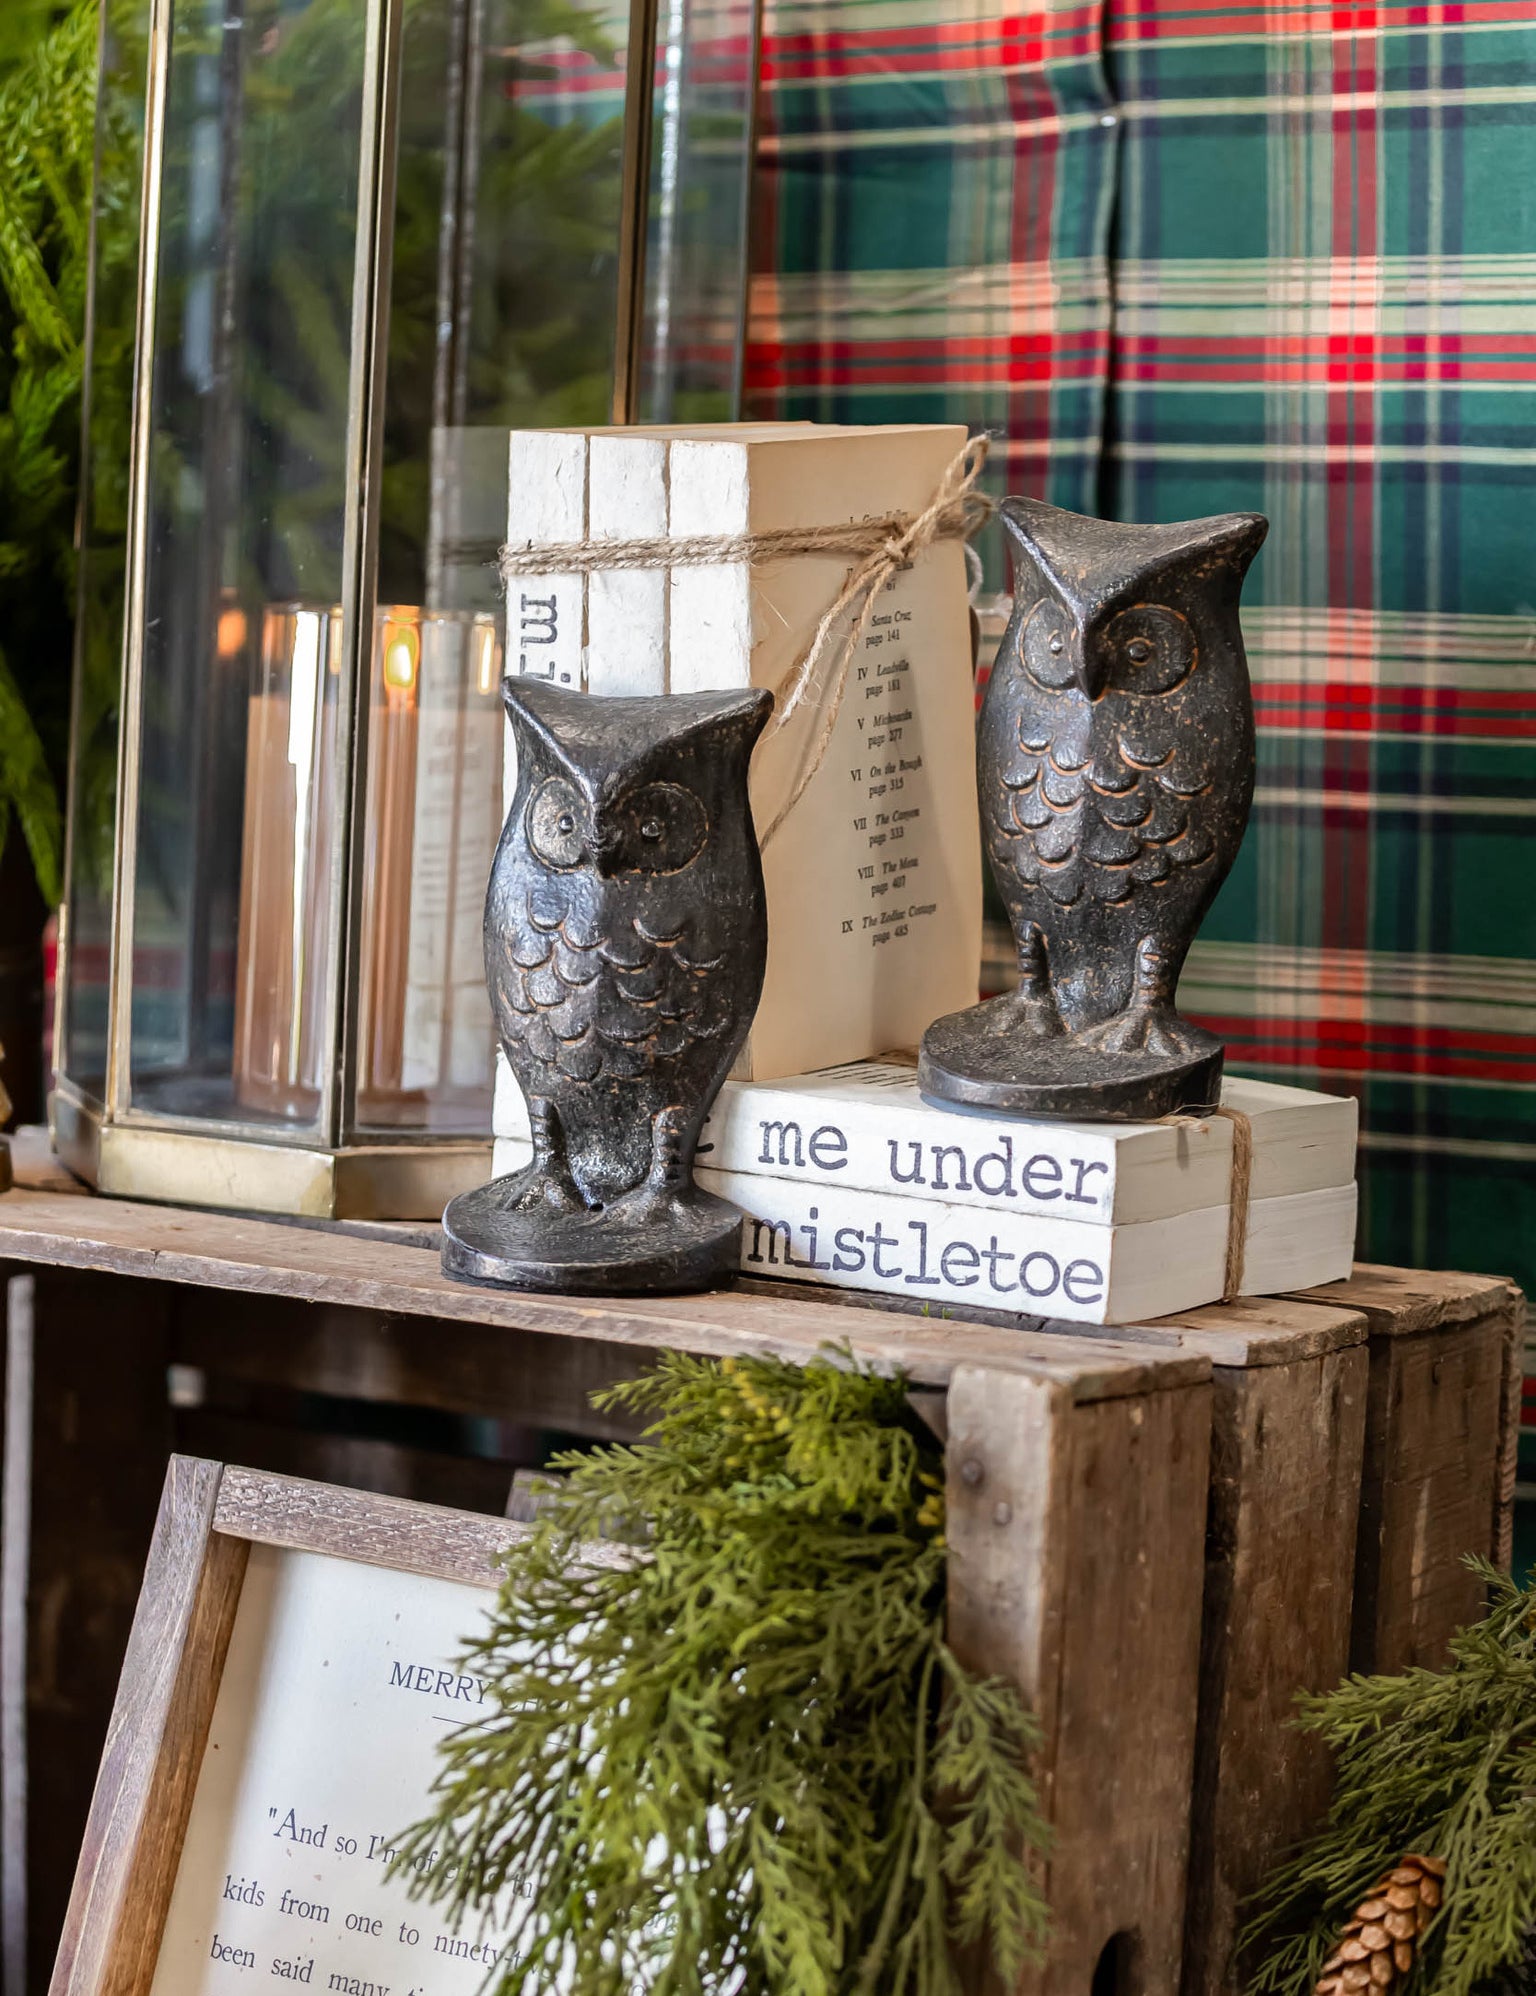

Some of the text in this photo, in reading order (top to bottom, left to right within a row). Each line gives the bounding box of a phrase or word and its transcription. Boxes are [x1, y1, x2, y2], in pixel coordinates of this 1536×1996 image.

[894, 610, 912, 623] Cruz
[865, 629, 900, 648] page 141
[857, 667, 868, 680] IV
[865, 686, 883, 699] page
[857, 718, 864, 730] V
[868, 732, 885, 749] page
[850, 769, 861, 781] VI
[870, 765, 882, 778] On
[884, 762, 896, 774] the
[869, 783, 886, 799] page
[853, 817, 867, 831] VII
[875, 813, 891, 828] The
[869, 832, 886, 848] page
[857, 865, 874, 880] VIII
[882, 861, 898, 875] The
[871, 882, 888, 898] page
[842, 920, 853, 934] IX
[862, 915, 878, 929] The
[872, 931, 890, 947] page
[758, 1120, 848, 1171] me
[887, 1134, 1109, 1205] under
[747, 1206, 1104, 1305] mistletoe
[388, 1660, 495, 1705] MERRY
[334, 1834, 358, 1857] so
[222, 1873, 266, 1907] kids
[279, 1889, 331, 1924] from
[344, 1912, 383, 1937] one
[398, 1921, 420, 1946] to
[209, 1934, 256, 1969] been
[270, 1956, 315, 1984] said
